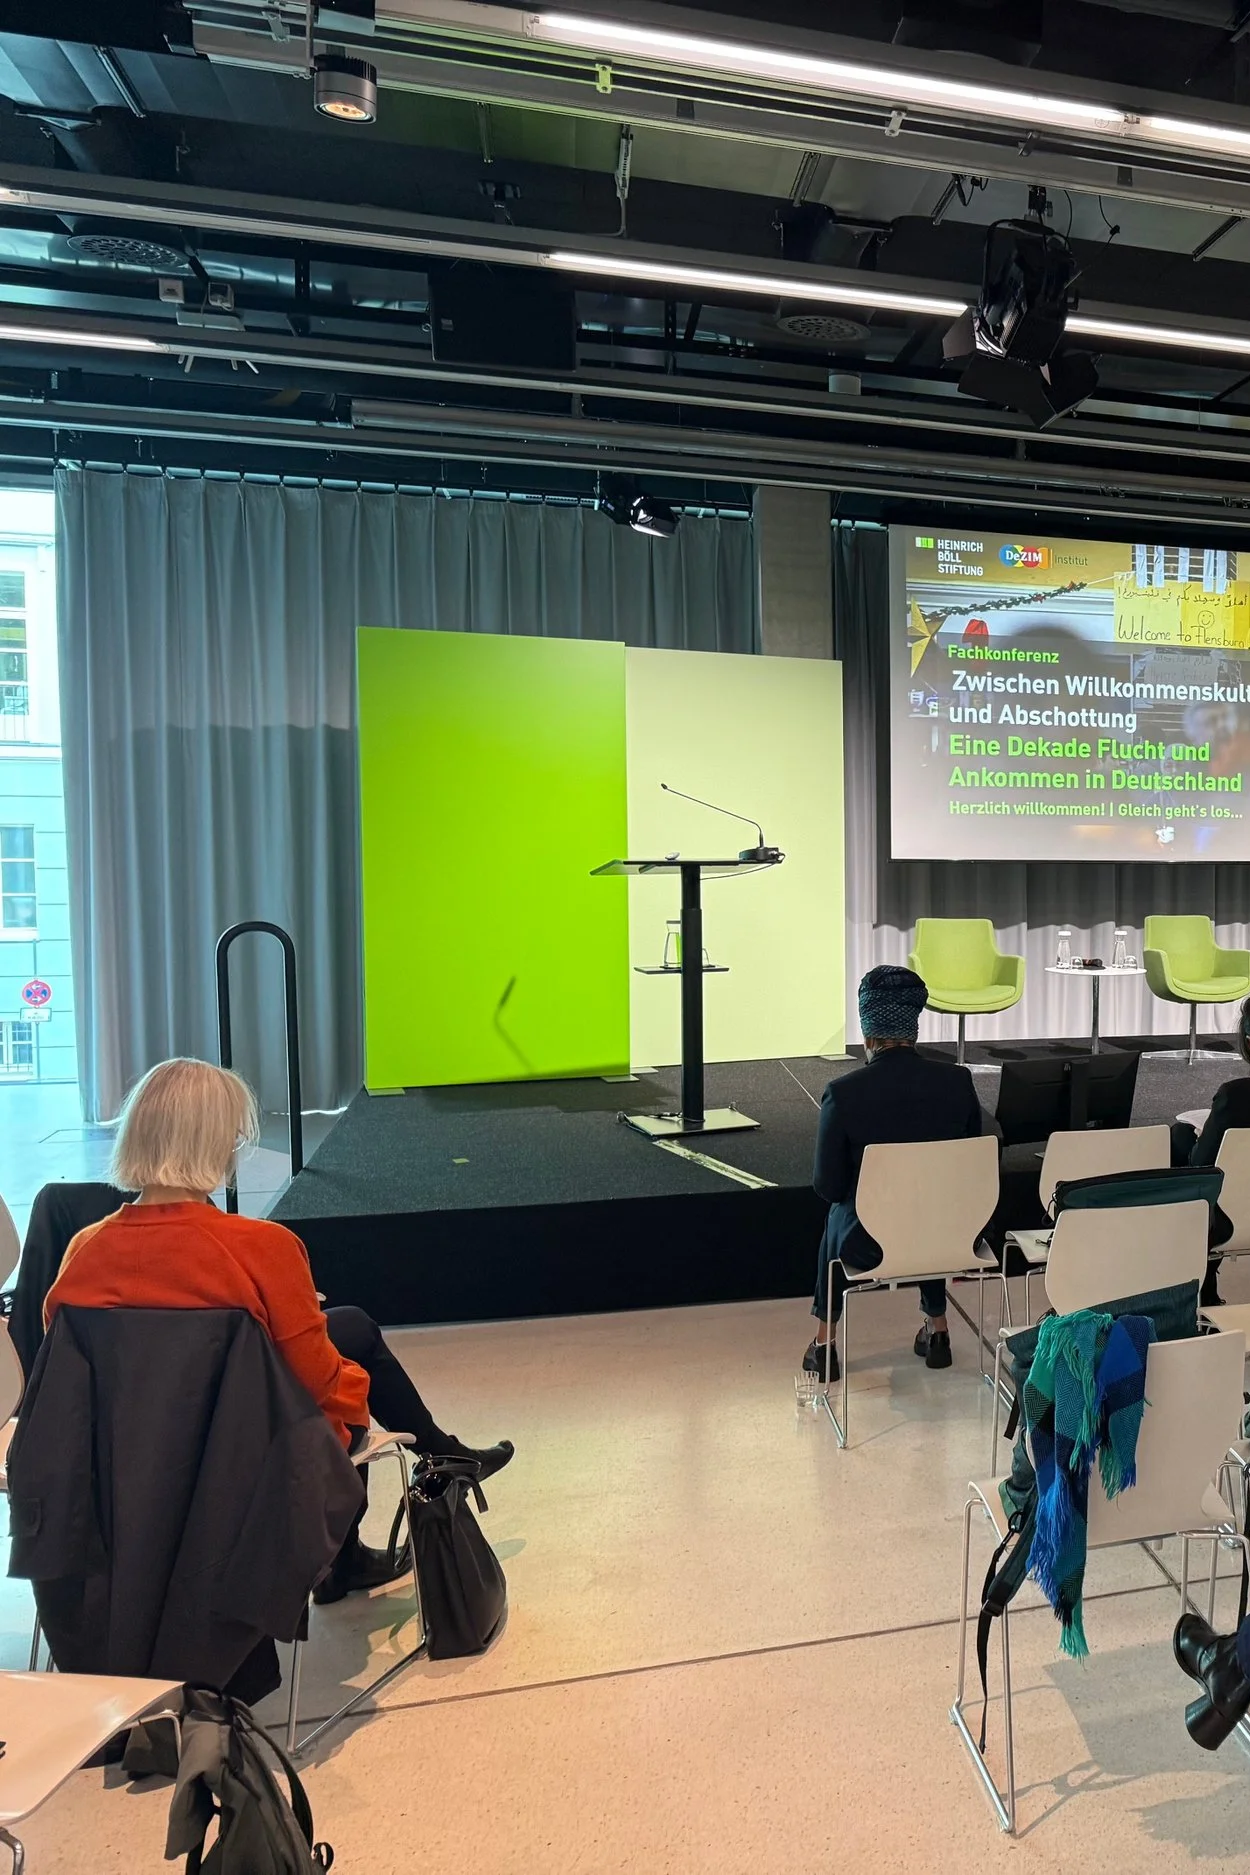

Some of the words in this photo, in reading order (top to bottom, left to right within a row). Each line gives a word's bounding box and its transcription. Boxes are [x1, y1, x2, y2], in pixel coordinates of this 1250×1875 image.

[937, 539, 983, 552] HEINRICH
[938, 551, 961, 563] BÖLL
[1006, 550, 1042, 562] DeZIM
[1054, 554, 1088, 566] Institut
[938, 564, 983, 576] STIFTUNG
[1118, 615, 1171, 641] Welcome
[1176, 620, 1192, 642] to
[947, 644, 1060, 664] Fachkonferenz
[952, 670, 1060, 695] Zwischen
[949, 704, 992, 724] und
[998, 704, 1137, 734] Abschottung
[949, 734, 1000, 756] Eine
[1007, 735, 1091, 758] Dekade
[1097, 738, 1166, 760] Flucht
[1171, 742, 1210, 761] und
[948, 766, 1079, 788] Ankommen
[1085, 769, 1105, 789] in
[1111, 769, 1242, 792] Deutschland
[949, 800, 1010, 815] Herzlich
[1013, 802, 1105, 816] willkommen!
[1118, 803, 1161, 817] Gleich
[1165, 804, 1208, 820] geht's
[1211, 805, 1243, 819] los...
